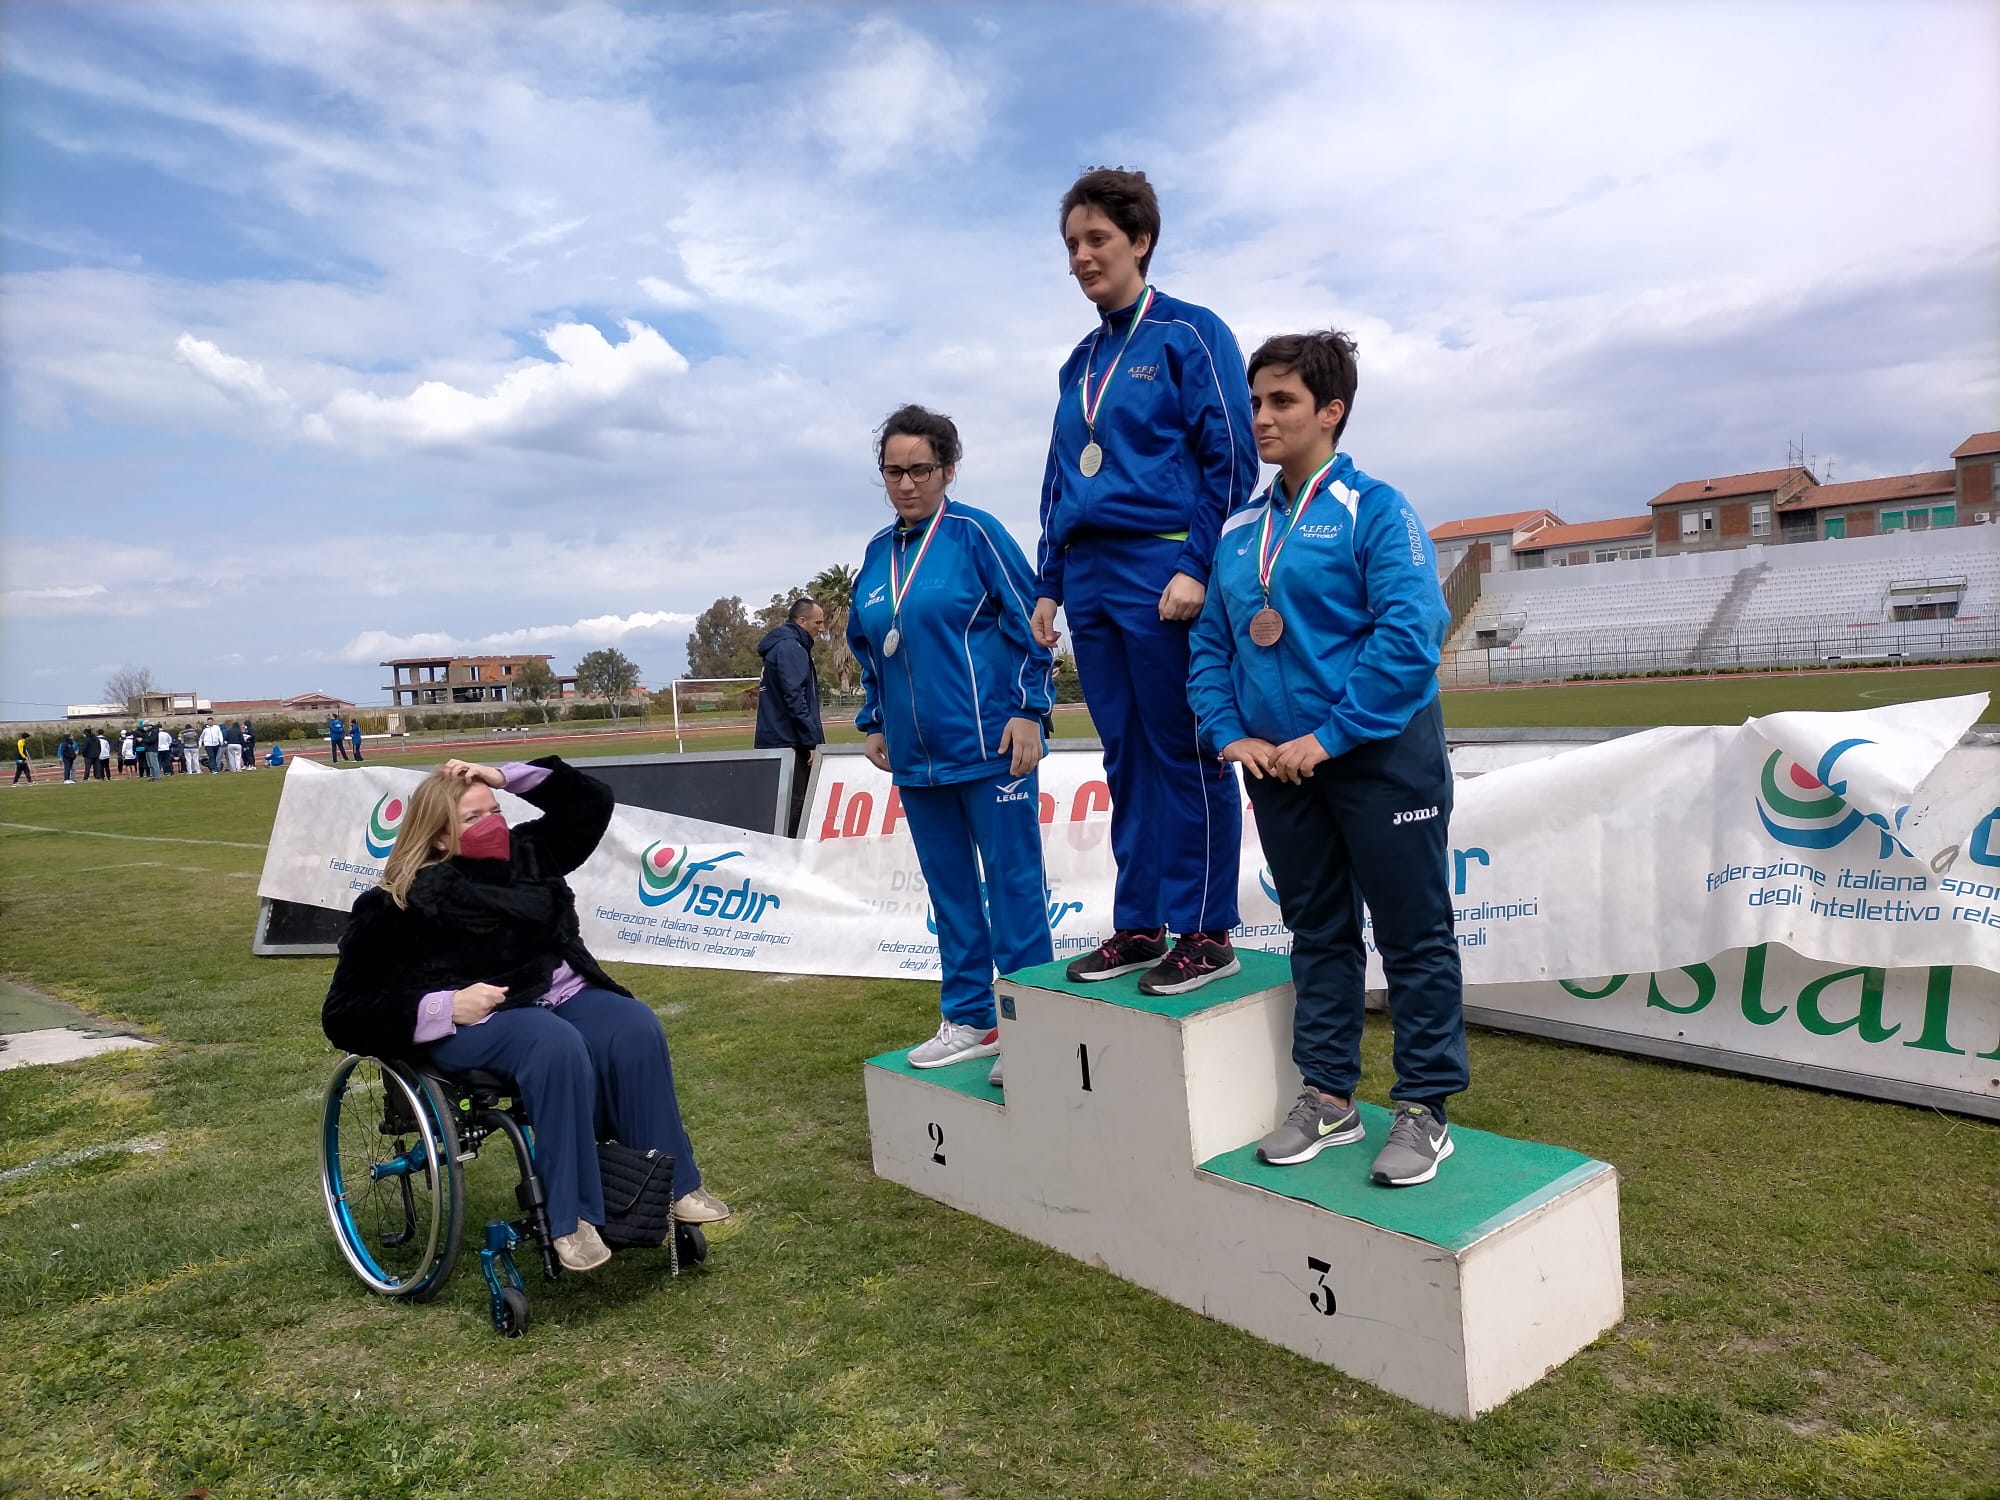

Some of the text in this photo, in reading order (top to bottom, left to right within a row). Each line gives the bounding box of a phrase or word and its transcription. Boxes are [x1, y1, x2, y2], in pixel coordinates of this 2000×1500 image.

[996, 791, 1029, 803] LEGEA
[1706, 857, 2000, 900] federazione italiana spor
[1452, 897, 1538, 921] aralimpici
[1749, 885, 1803, 906] degli
[1810, 892, 1940, 922] intellettivo
[596, 906, 793, 945] federazione italiana sport paralimpici
[618, 928, 758, 958] degli intellettivo relazionali
[877, 940, 941, 954] federazion
[899, 958, 930, 971] degli
[1075, 1043, 1092, 1092] 1
[927, 1122, 947, 1166] 2
[1308, 1255, 1337, 1316] 3
